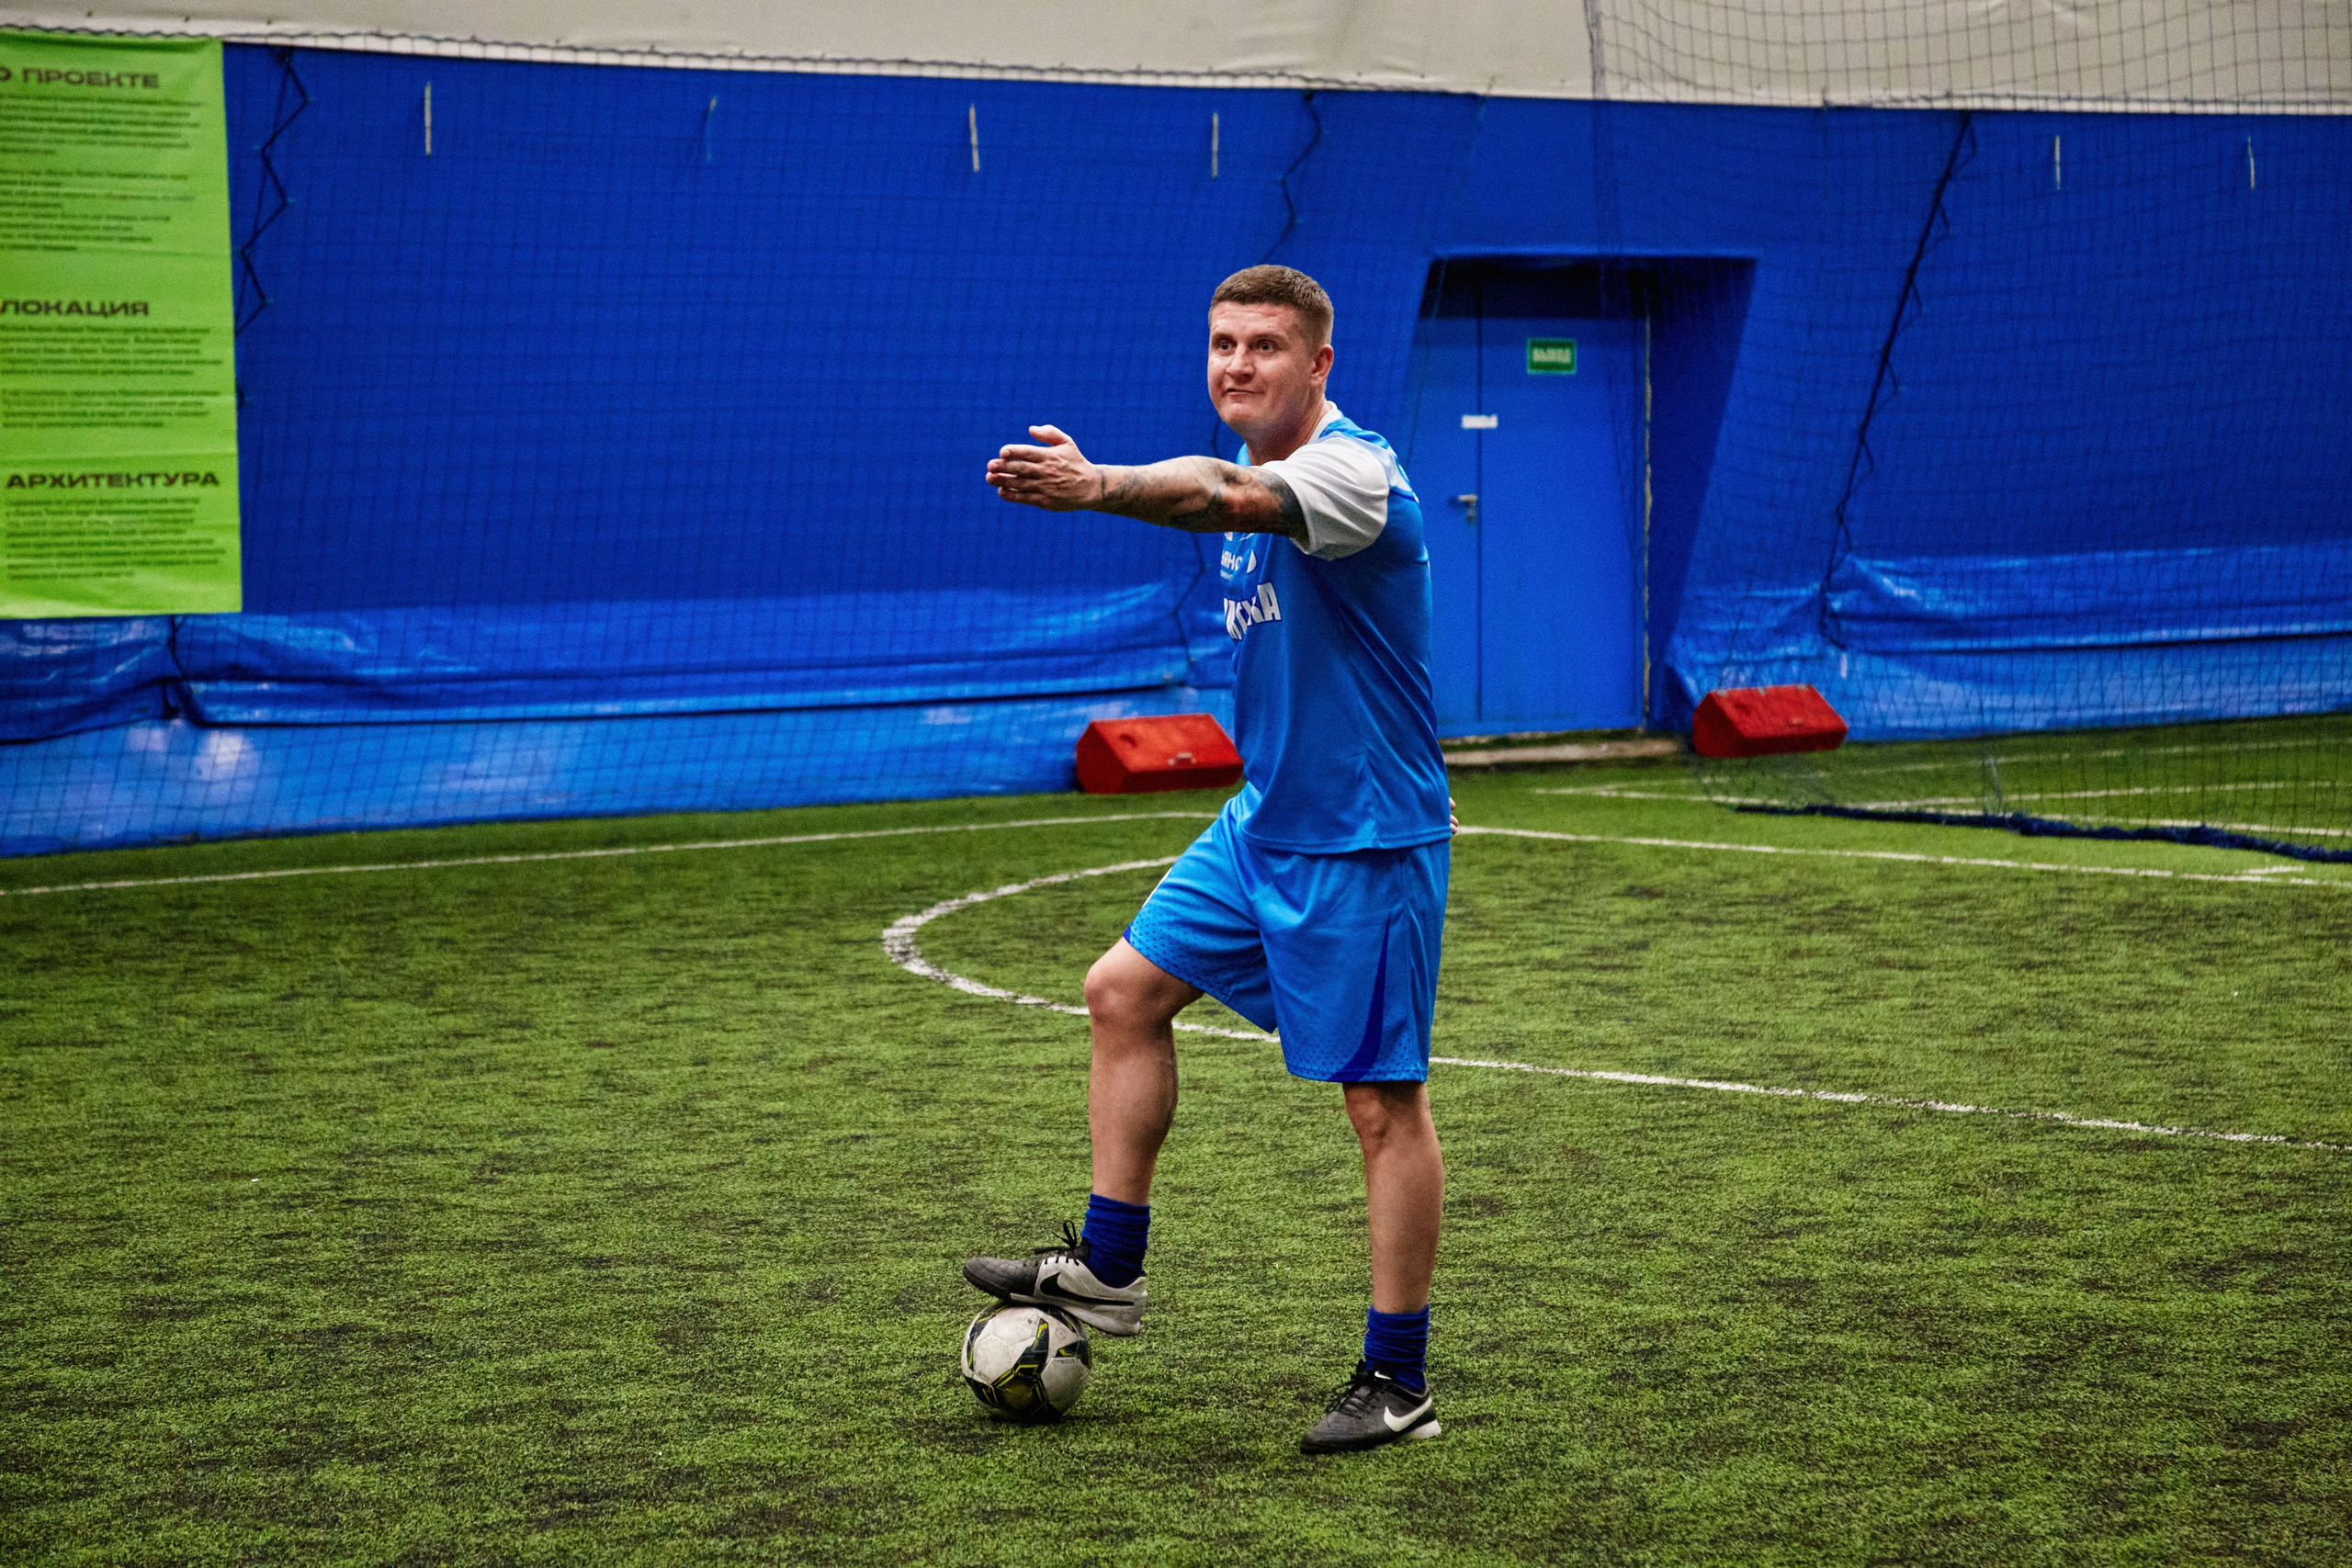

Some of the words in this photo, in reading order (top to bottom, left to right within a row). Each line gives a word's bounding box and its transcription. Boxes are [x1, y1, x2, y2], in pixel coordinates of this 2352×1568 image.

[22, 68, 160, 88] ПРОЕКТЕ
[0, 299, 150, 317] ЛОКАЦИЯ
[6, 472, 220, 490] АРХИТЕКТУРА
